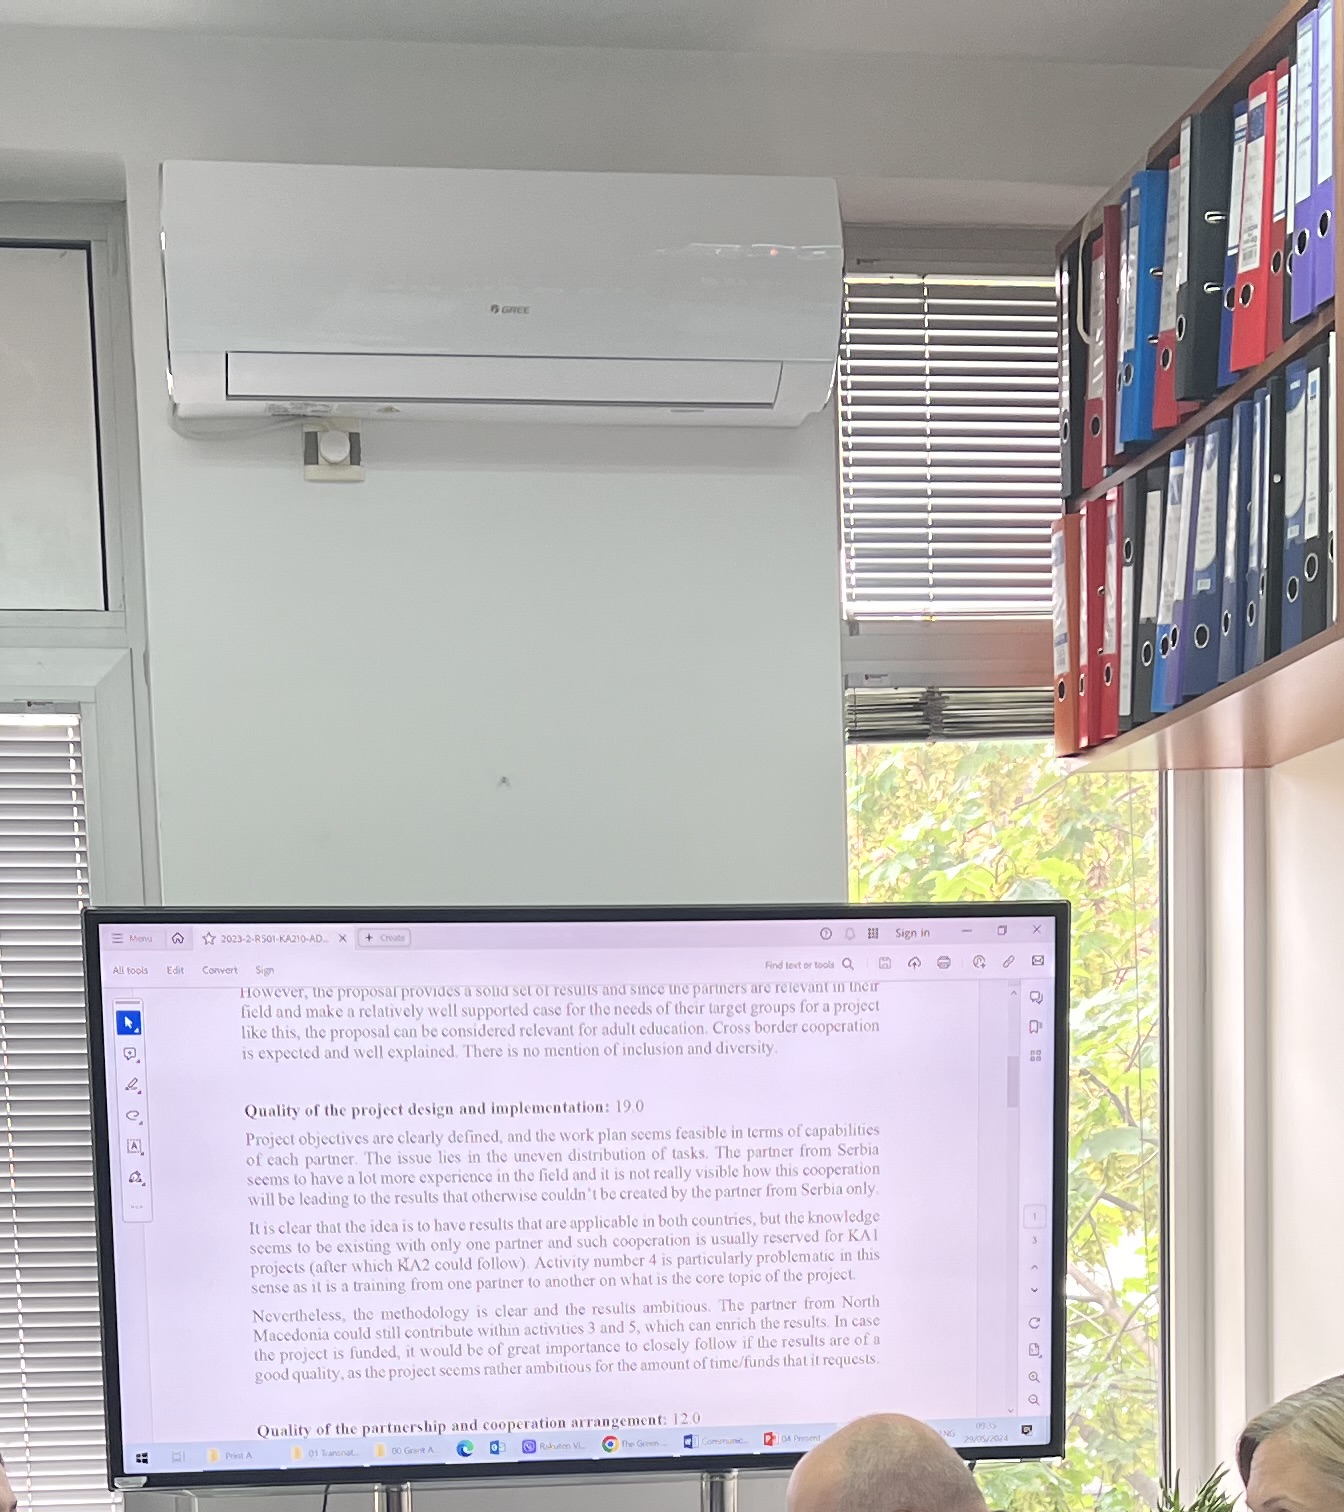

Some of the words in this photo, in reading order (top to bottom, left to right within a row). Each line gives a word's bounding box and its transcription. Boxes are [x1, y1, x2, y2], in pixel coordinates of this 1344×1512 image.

[380, 934, 405, 942] Create
[896, 928, 917, 940] Sign
[921, 928, 930, 937] in
[113, 966, 124, 974] All
[127, 966, 148, 975] tools
[167, 966, 184, 974] Edit
[202, 966, 238, 974] Convert
[256, 966, 274, 977] Sign
[765, 960, 783, 970] Find
[814, 960, 834, 969] tools
[241, 1024, 267, 1039] like
[305, 1024, 326, 1039] the
[329, 1023, 390, 1041] proposal
[393, 1027, 417, 1038] can
[421, 1023, 438, 1038] be
[441, 1022, 516, 1038] considered
[519, 1022, 574, 1037] relevant
[578, 1021, 598, 1037] for
[601, 1021, 635, 1036] adult
[712, 1020, 750, 1034] Cross
[754, 1019, 798, 1034] border
[801, 1017, 879, 1036] cooperation
[242, 1045, 253, 1060] is
[258, 1044, 320, 1063] expected
[324, 1044, 349, 1059] and
[353, 1044, 383, 1059] well
[462, 1043, 503, 1058] There
[507, 1044, 518, 1057] is
[522, 1046, 540, 1057] no
[544, 1042, 599, 1057] mention
[603, 1041, 620, 1056] of
[622, 1041, 683, 1056] inclusion
[687, 1040, 712, 1055] and
[244, 1103, 300, 1121] Quality
[304, 1103, 320, 1117] of
[324, 1103, 346, 1116] the
[351, 1102, 403, 1120] project
[407, 1101, 454, 1119] design
[459, 1101, 486, 1115] and
[616, 1099, 644, 1113] 19.0
[245, 1131, 295, 1148] Project
[298, 1130, 369, 1147] objectives
[372, 1134, 394, 1144] are
[397, 1130, 443, 1146] clearly
[507, 1128, 531, 1142] and
[535, 1128, 556, 1142] the
[559, 1127, 594, 1141] work
[597, 1127, 626, 1143] plan
[630, 1129, 671, 1140] seems
[675, 1125, 727, 1140] feasible
[731, 1124, 743, 1139] in
[747, 1127, 783, 1138] terms
[787, 1123, 803, 1138] of
[804, 1122, 880, 1140] capabilities
[249, 1243, 292, 1254] seems
[297, 1241, 310, 1254] to
[315, 1239, 332, 1253] be
[336, 1238, 391, 1255] existing
[395, 1237, 425, 1251] with
[430, 1237, 461, 1254] only
[465, 1240, 490, 1251] one
[494, 1237, 543, 1253] partner
[547, 1234, 572, 1249] and
[576, 1234, 607, 1248] such
[612, 1232, 690, 1250] cooperation
[695, 1232, 706, 1245] is
[710, 1230, 759, 1247] usually
[763, 1229, 819, 1244] reserved
[824, 1228, 844, 1242] for
[353, 1307, 374, 1320] the
[380, 1305, 469, 1321] methodology
[476, 1304, 488, 1318] is
[494, 1304, 528, 1317] clear
[533, 1302, 558, 1316] and
[565, 1302, 585, 1316] the
[591, 1301, 636, 1315] results
[717, 1298, 744, 1312] The
[750, 1298, 797, 1314] partner
[803, 1295, 835, 1309] from
[841, 1294, 880, 1308] North
[252, 1327, 329, 1342] Macedonia
[333, 1326, 371, 1340] could
[375, 1325, 401, 1339] still
[404, 1324, 473, 1339] contribute
[477, 1322, 520, 1337] within
[523, 1321, 584, 1336] activities
[587, 1321, 595, 1334] 3
[599, 1320, 624, 1334] and
[644, 1318, 684, 1332] which
[688, 1321, 711, 1331] can
[715, 1316, 756, 1331] enrich
[760, 1316, 780, 1329] the
[834, 1314, 847, 1327] In
[851, 1316, 880, 1327] case
[257, 1423, 310, 1439] Quality
[316, 1422, 332, 1435] of
[335, 1422, 357, 1434] the
[361, 1419, 446, 1437] partnership
[451, 1418, 477, 1432] and
[482, 1416, 565, 1433] cooperation
[673, 1411, 701, 1426] 12.0
